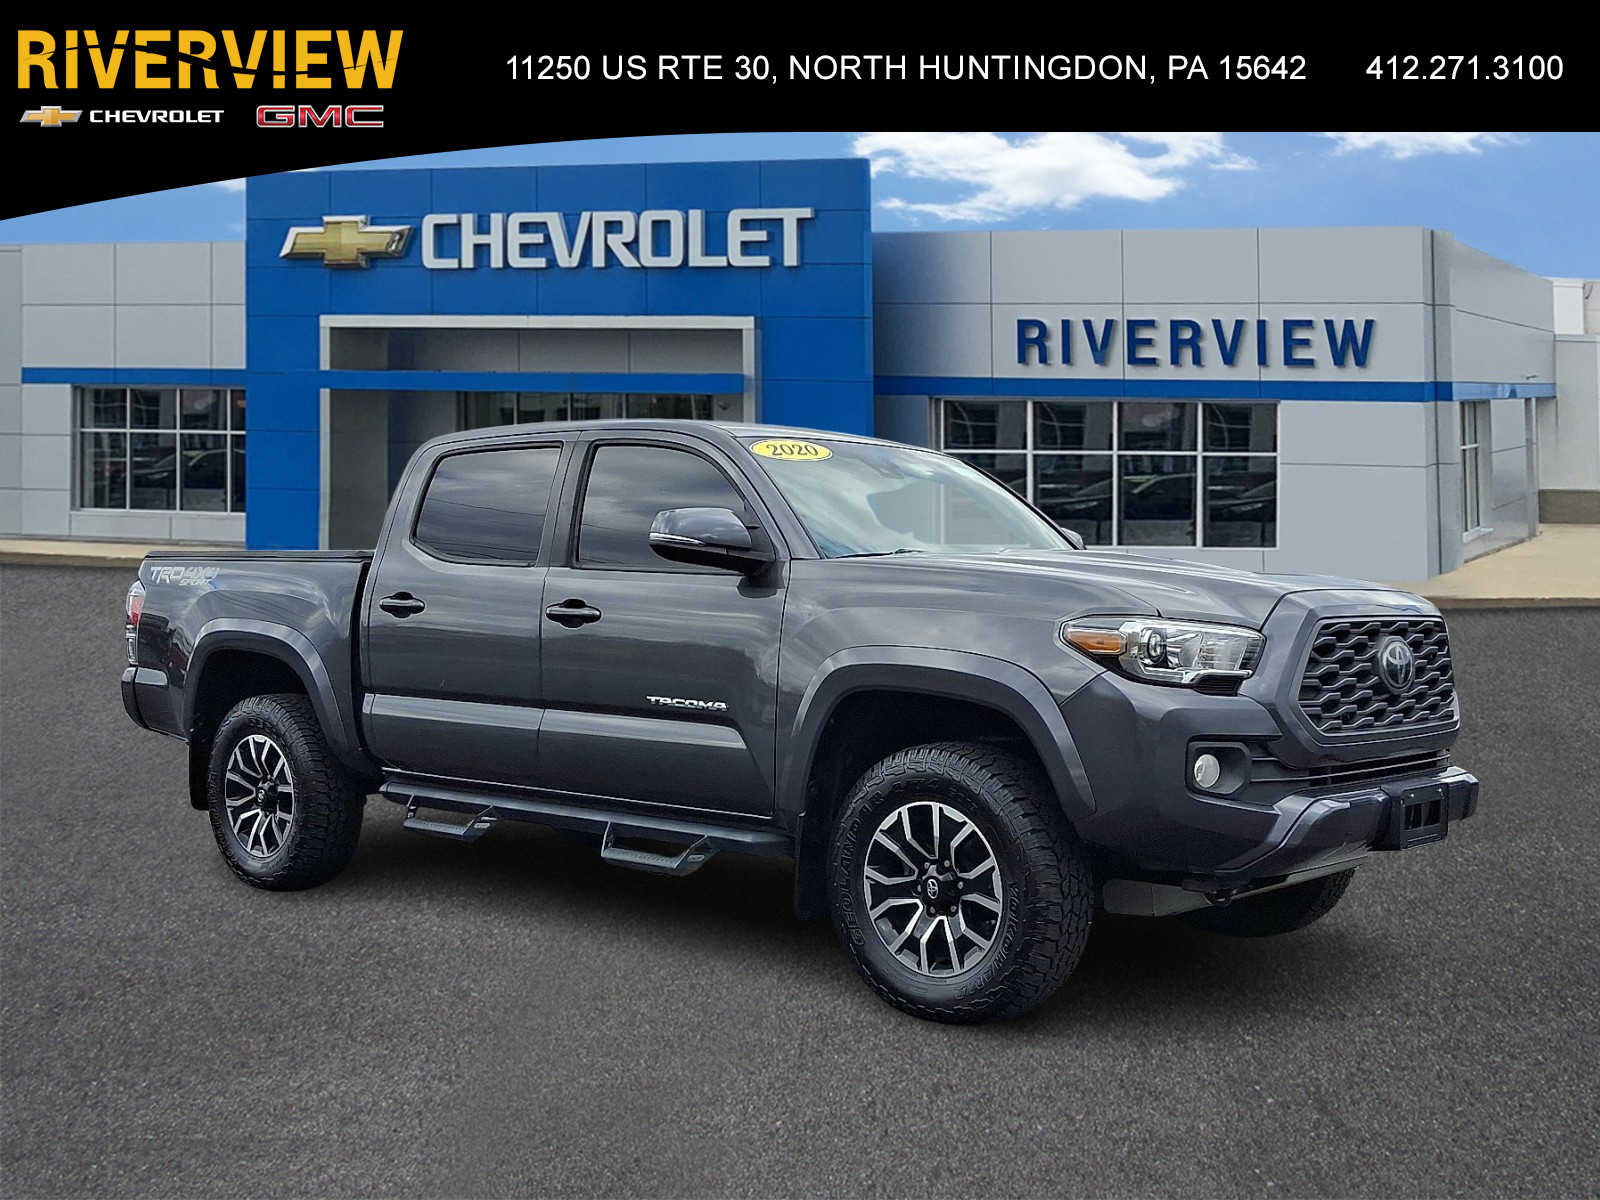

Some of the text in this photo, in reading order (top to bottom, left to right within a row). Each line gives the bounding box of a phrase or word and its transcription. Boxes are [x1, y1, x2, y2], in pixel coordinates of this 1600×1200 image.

[421, 207, 814, 269] CHEVROLET
[1016, 318, 1375, 368] RIVERVIEW
[766, 443, 819, 456] 2020
[646, 695, 729, 711] TACOMA
